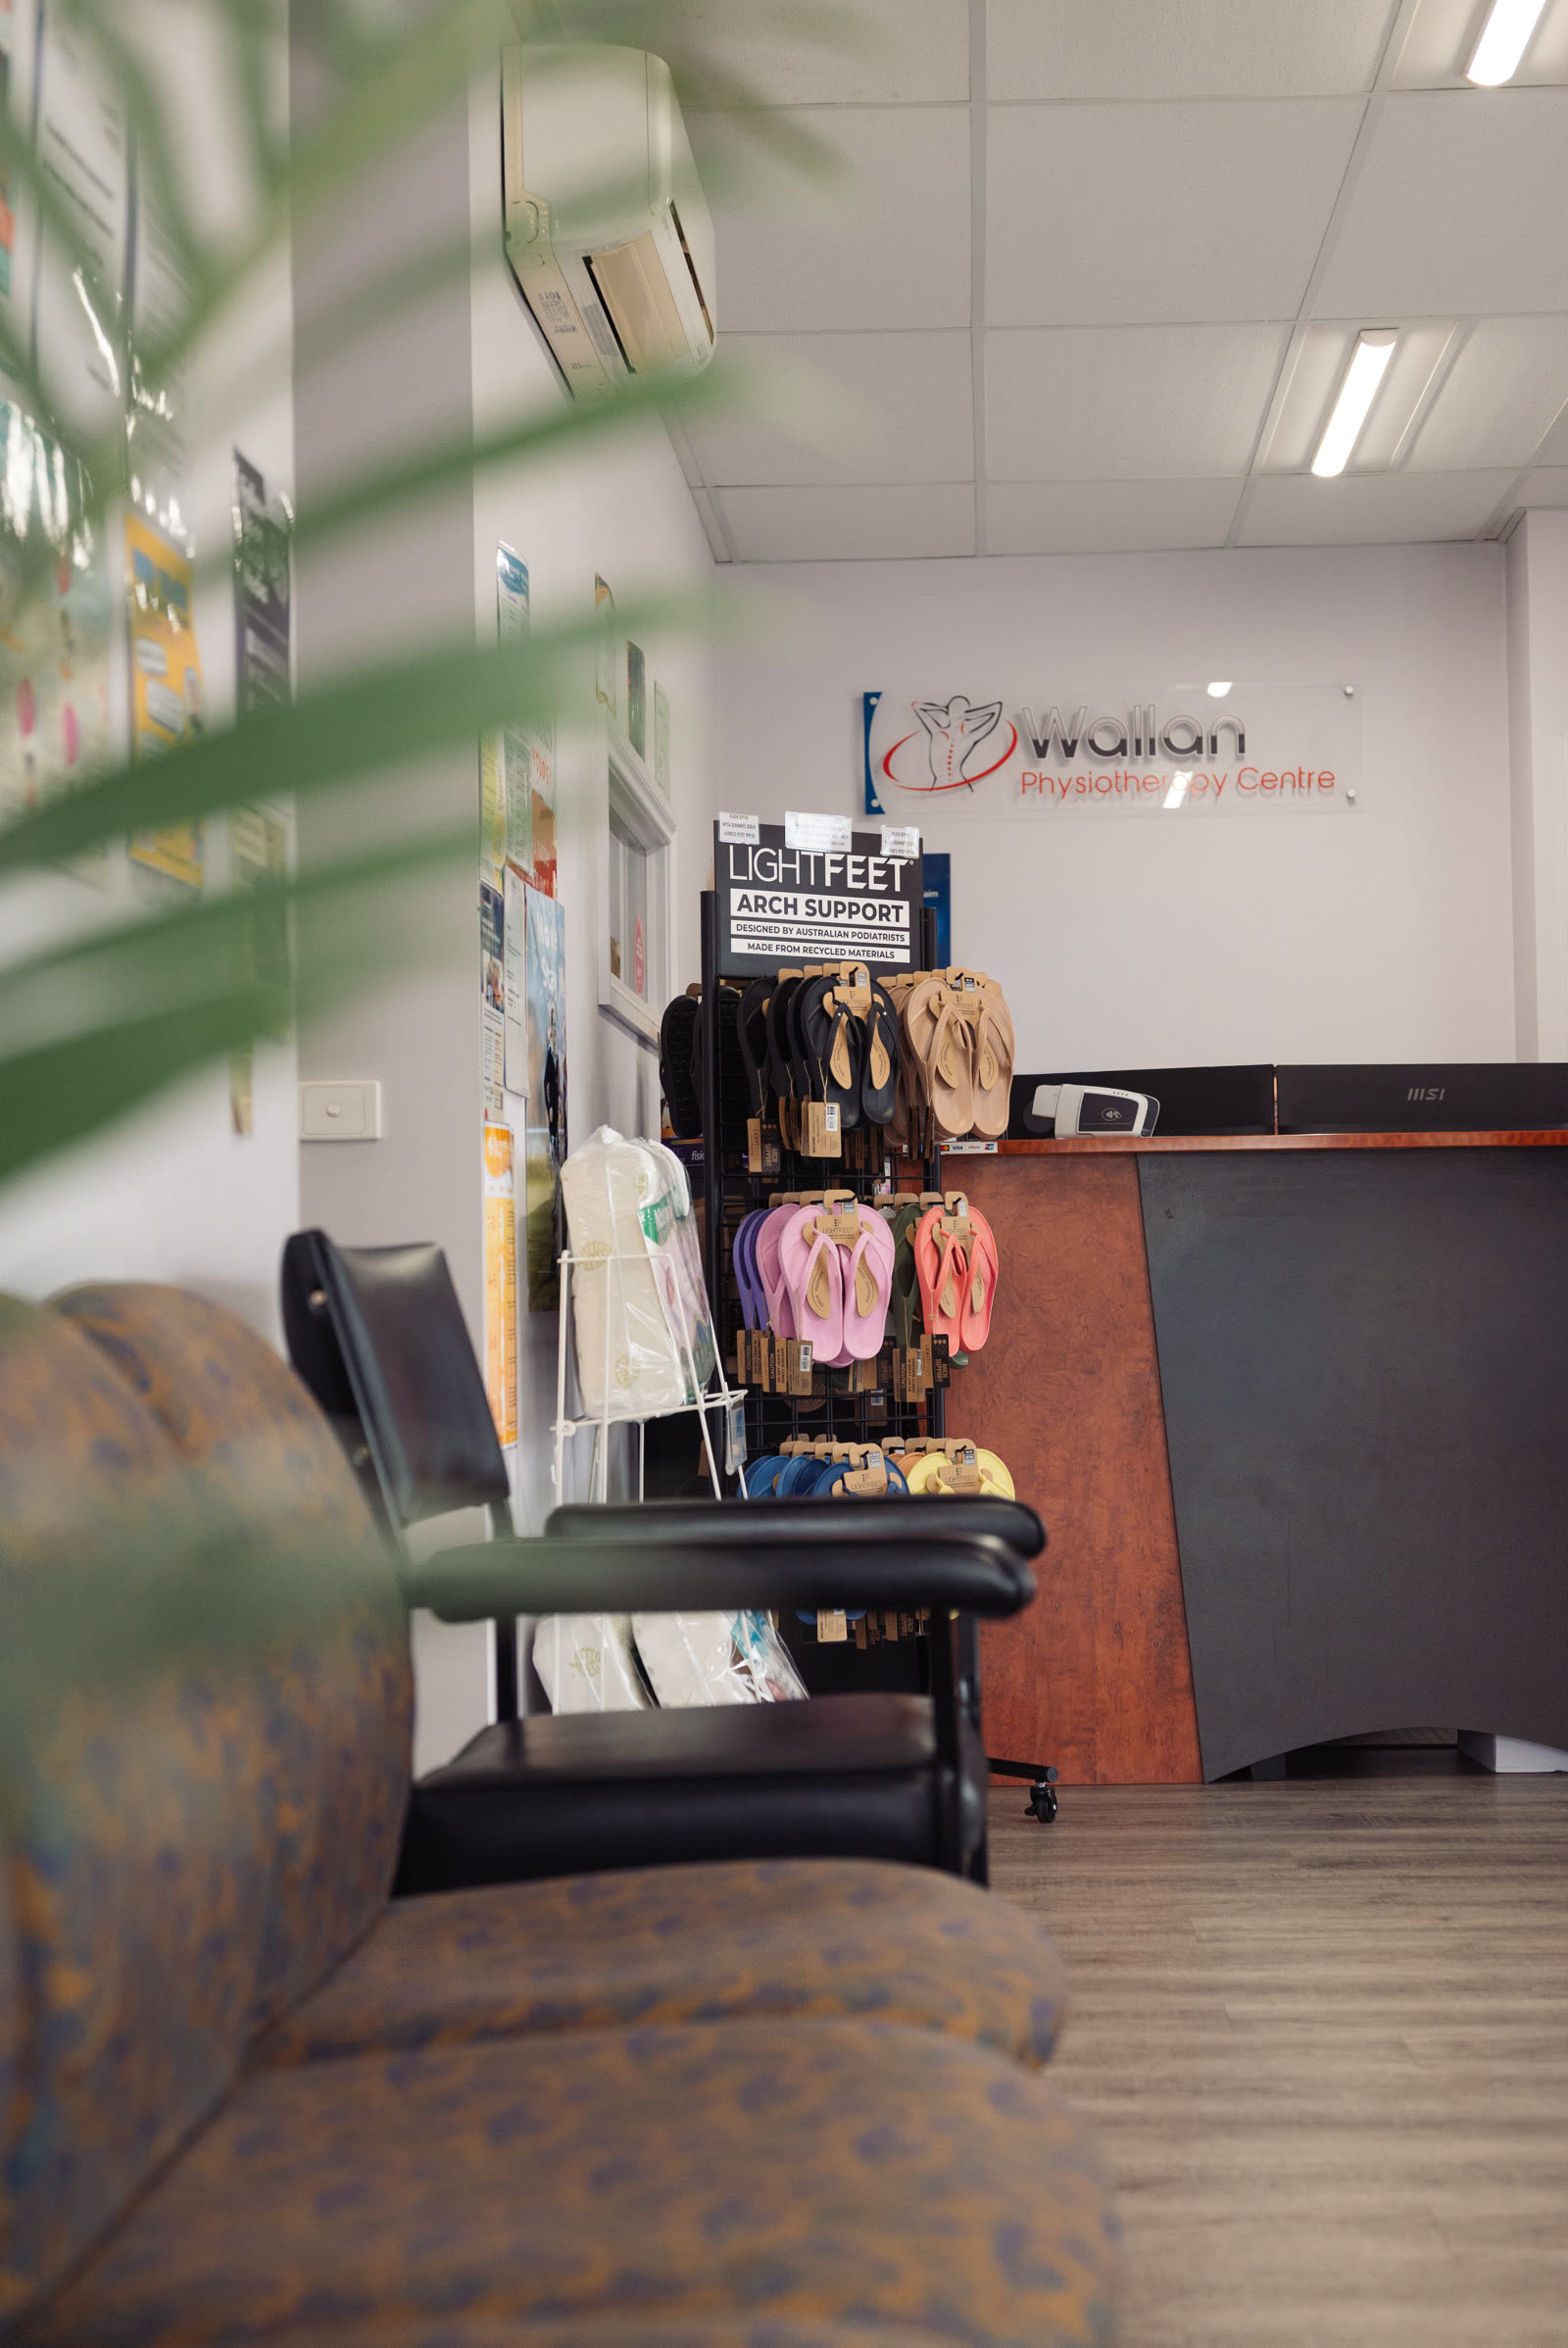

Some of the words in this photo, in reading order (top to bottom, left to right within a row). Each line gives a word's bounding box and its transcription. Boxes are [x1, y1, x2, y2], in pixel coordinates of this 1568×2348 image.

[1022, 704, 1246, 758] Wallan
[1238, 766, 1335, 791] Centre
[729, 845, 909, 892] LIGHTFEET
[737, 894, 798, 915] ARCH
[805, 899, 904, 922] SUPPORT
[736, 923, 780, 934] DESIGNED
[782, 926, 794, 935] BY
[796, 927, 849, 939] AUSTRALIAN
[852, 930, 906, 942] PODIATRISTS
[747, 943, 773, 952] MADE
[775, 944, 801, 954] FROM
[803, 946, 847, 956] RECYCLED
[848, 949, 895, 958] MATERIALS
